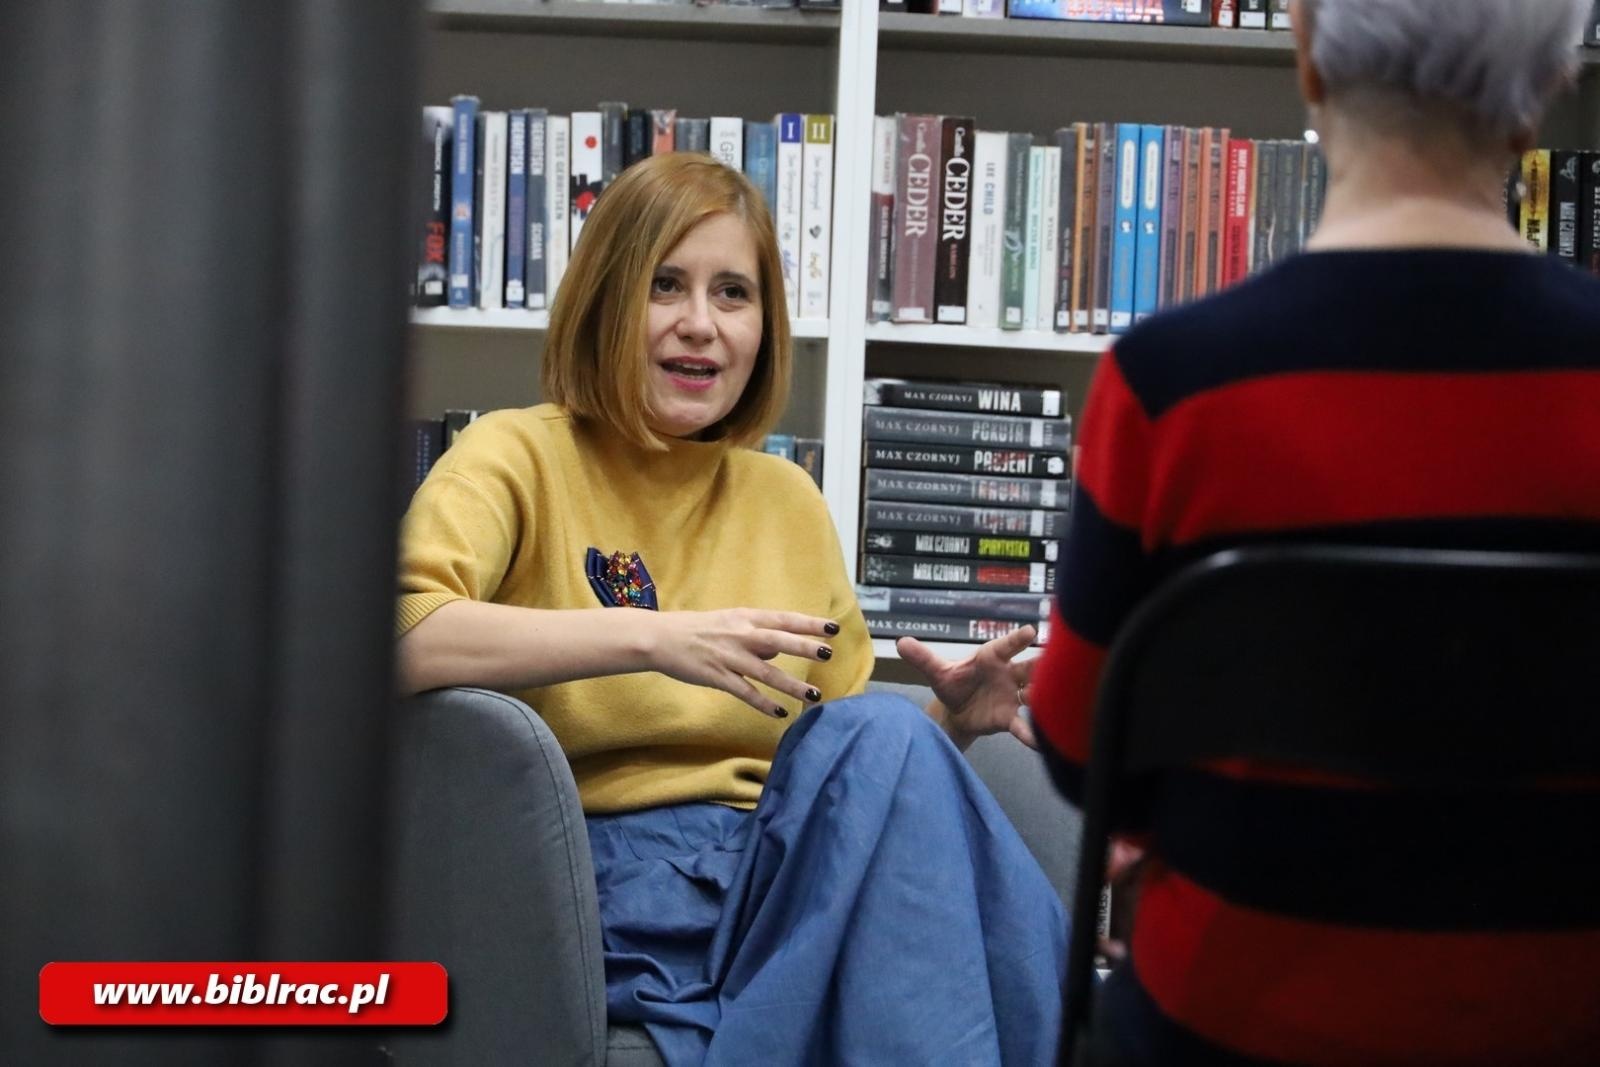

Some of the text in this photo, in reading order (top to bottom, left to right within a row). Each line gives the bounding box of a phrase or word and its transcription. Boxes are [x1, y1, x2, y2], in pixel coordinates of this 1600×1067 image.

[786, 122, 795, 139] I
[811, 122, 825, 140] II
[719, 141, 735, 164] GR
[554, 131, 566, 220] TESS GERRITSEN
[985, 162, 996, 179] LEE
[904, 154, 932, 238] CEDER
[942, 157, 971, 241] CEDER
[983, 182, 996, 216] CHILD
[1235, 195, 1246, 217] CLARK
[425, 221, 445, 264] FOX
[903, 389, 1022, 412] MAX CZORNYJ WINA
[874, 419, 1025, 443] MAX CZORNYJ POKUTA
[874, 449, 1036, 474] MAX CZORNYJ PACJENT
[876, 478, 904, 490] MAX
[906, 480, 962, 494] CZORNYJ
[876, 510, 903, 521] MAX
[906, 511, 962, 526] CZORNYJ
[915, 534, 934, 552] MAX
[934, 536, 970, 555] CZORNYJ
[912, 562, 933, 580] MAX
[933, 564, 970, 583] CZORNYJ
[866, 619, 892, 630] MAX
[896, 621, 951, 634] CZORNYJ
